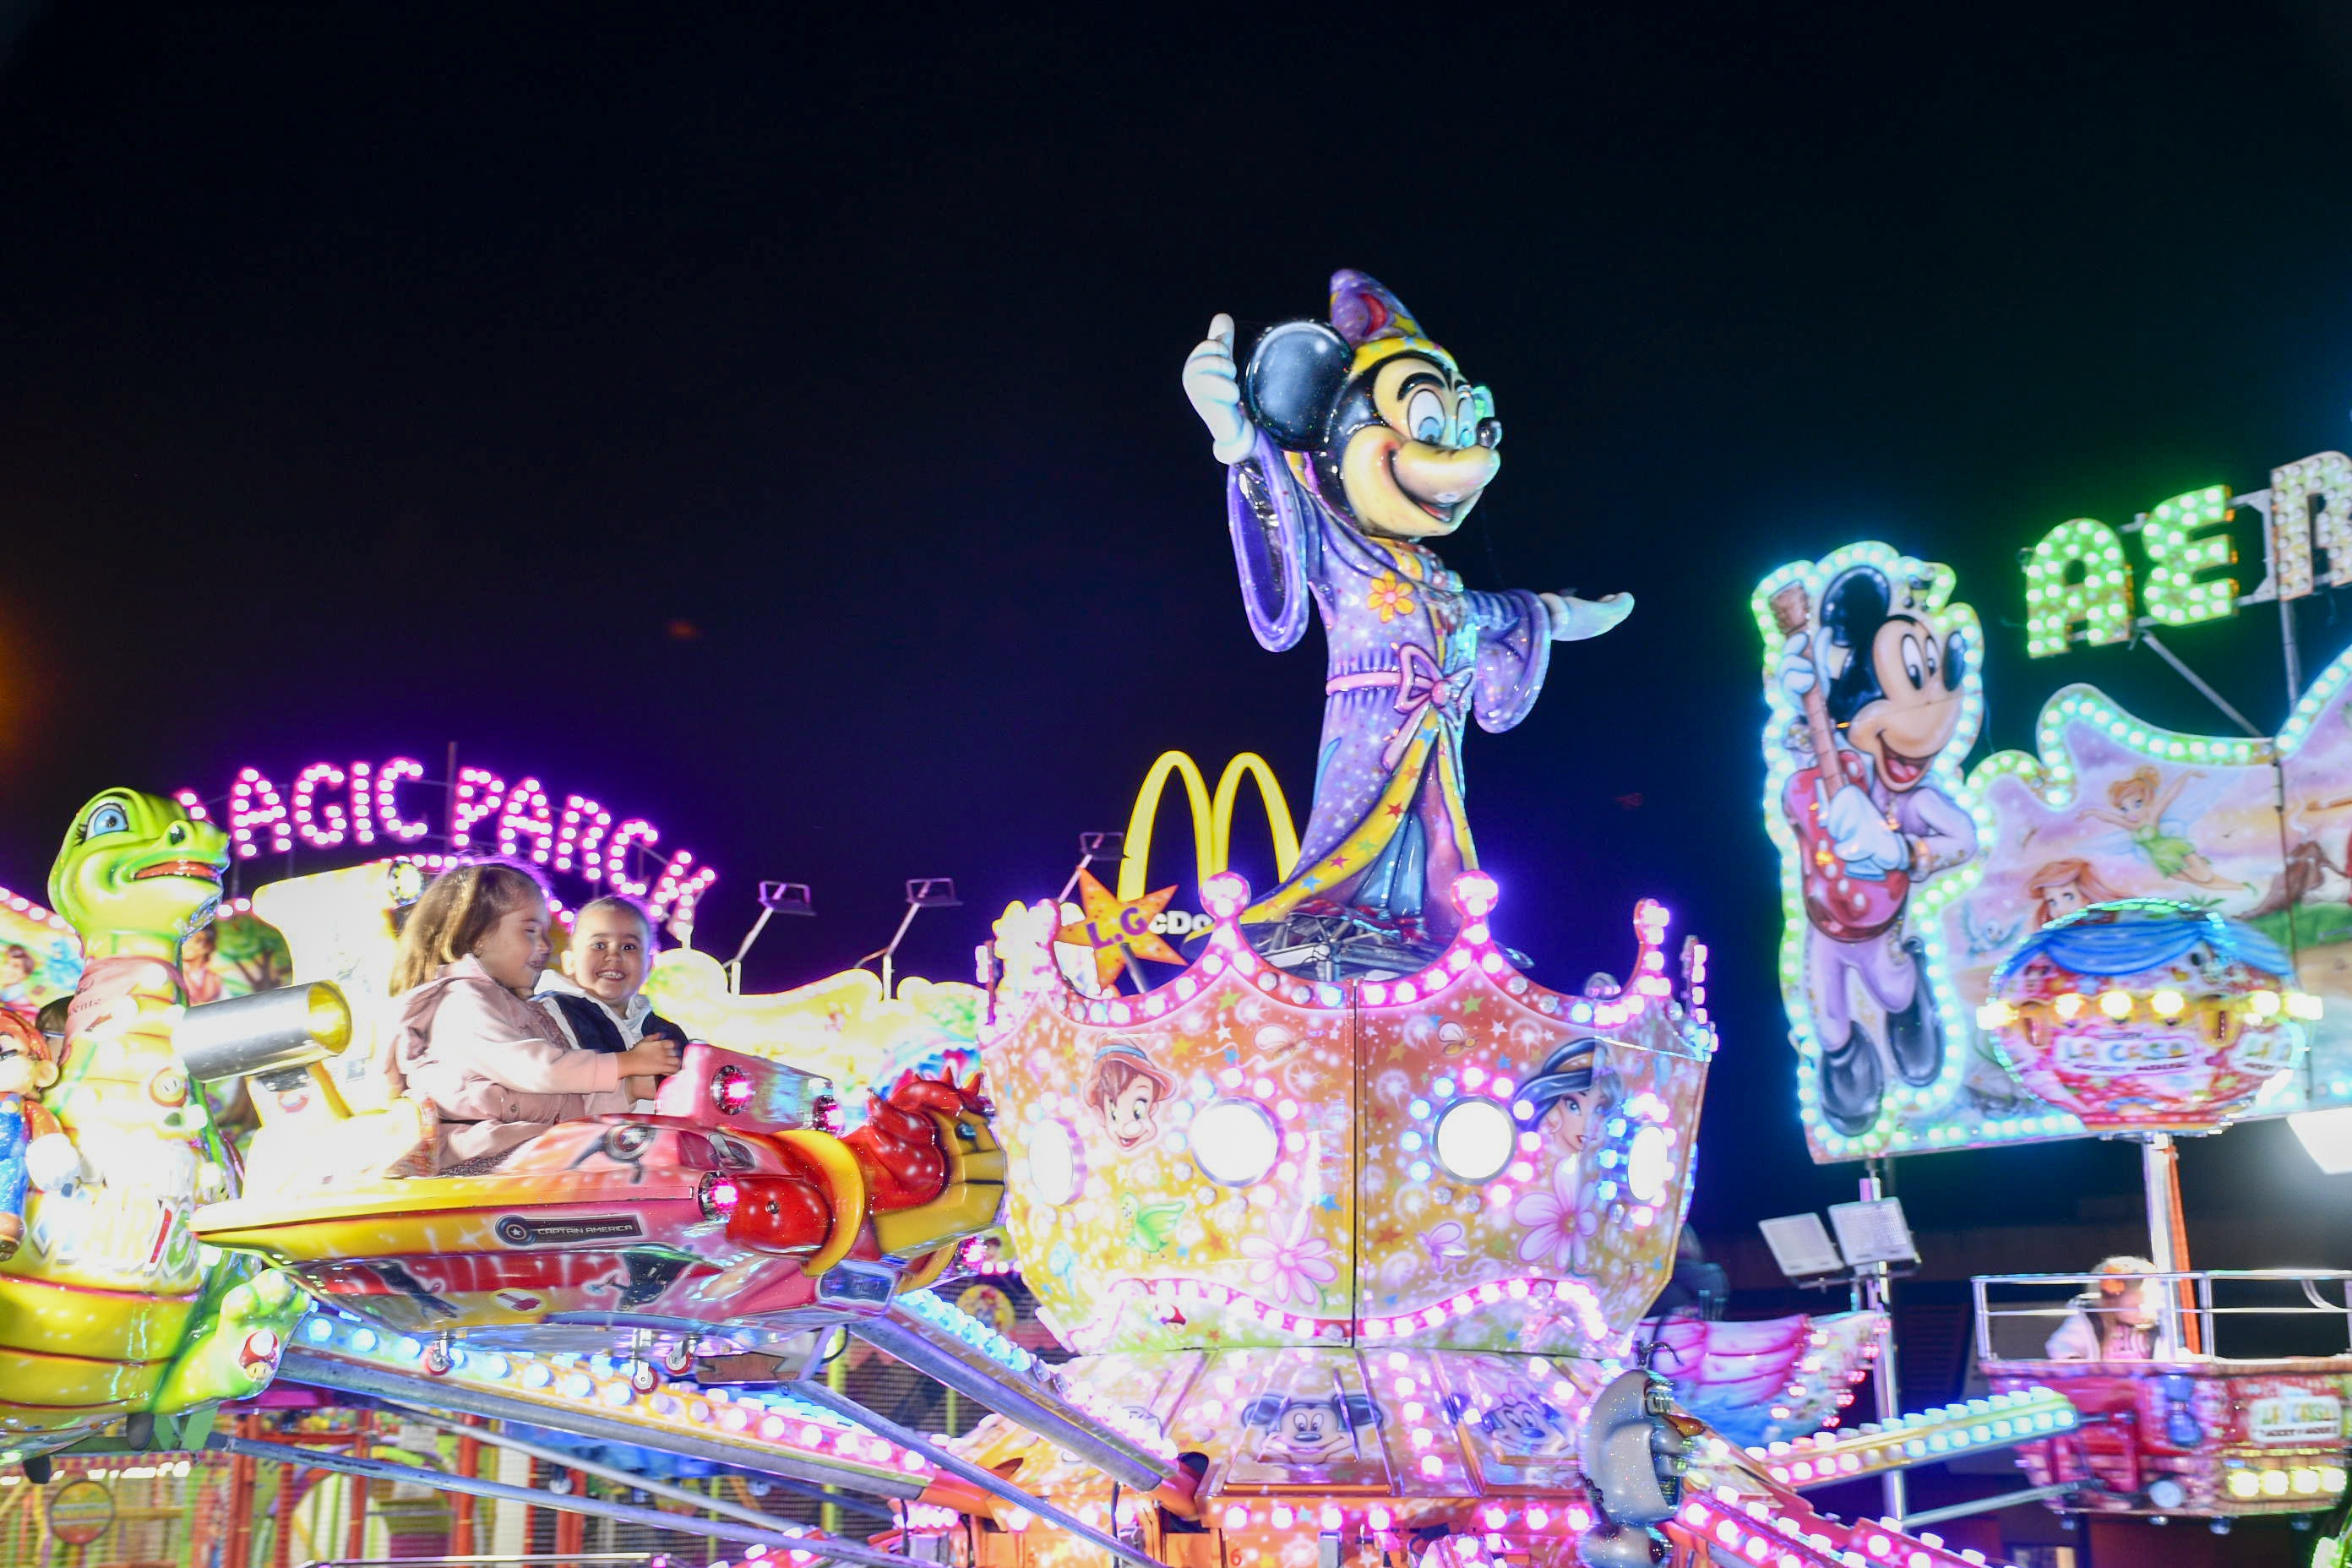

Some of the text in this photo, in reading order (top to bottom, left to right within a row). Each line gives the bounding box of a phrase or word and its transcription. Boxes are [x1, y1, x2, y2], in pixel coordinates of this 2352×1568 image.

[172, 757, 718, 938] AGIC PARCK
[537, 1224, 634, 1236] CAPTAIN AMERICA
